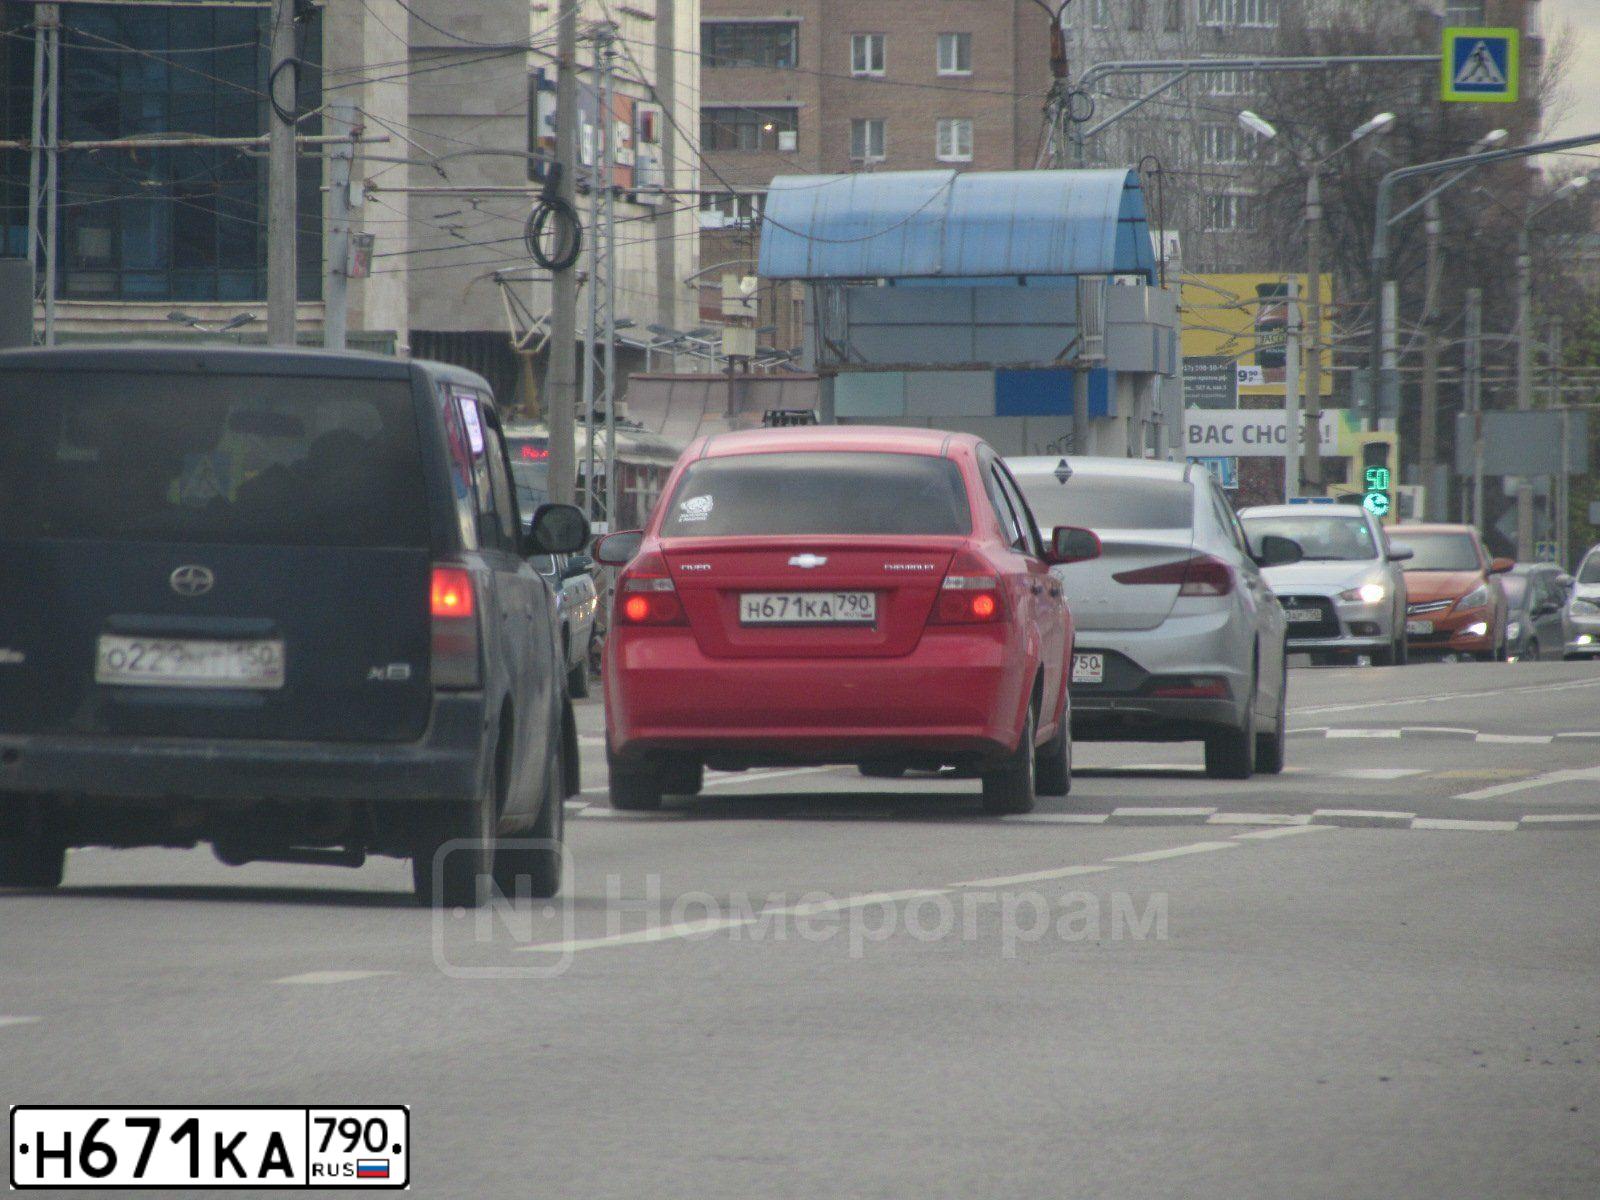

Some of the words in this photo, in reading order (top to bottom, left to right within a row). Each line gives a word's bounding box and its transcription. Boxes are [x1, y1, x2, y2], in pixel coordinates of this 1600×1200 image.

[1188, 425, 1234, 444] ВАС
[1367, 468, 1389, 490] 50
[748, 596, 833, 618] Н671КА
[837, 595, 869, 611] 790
